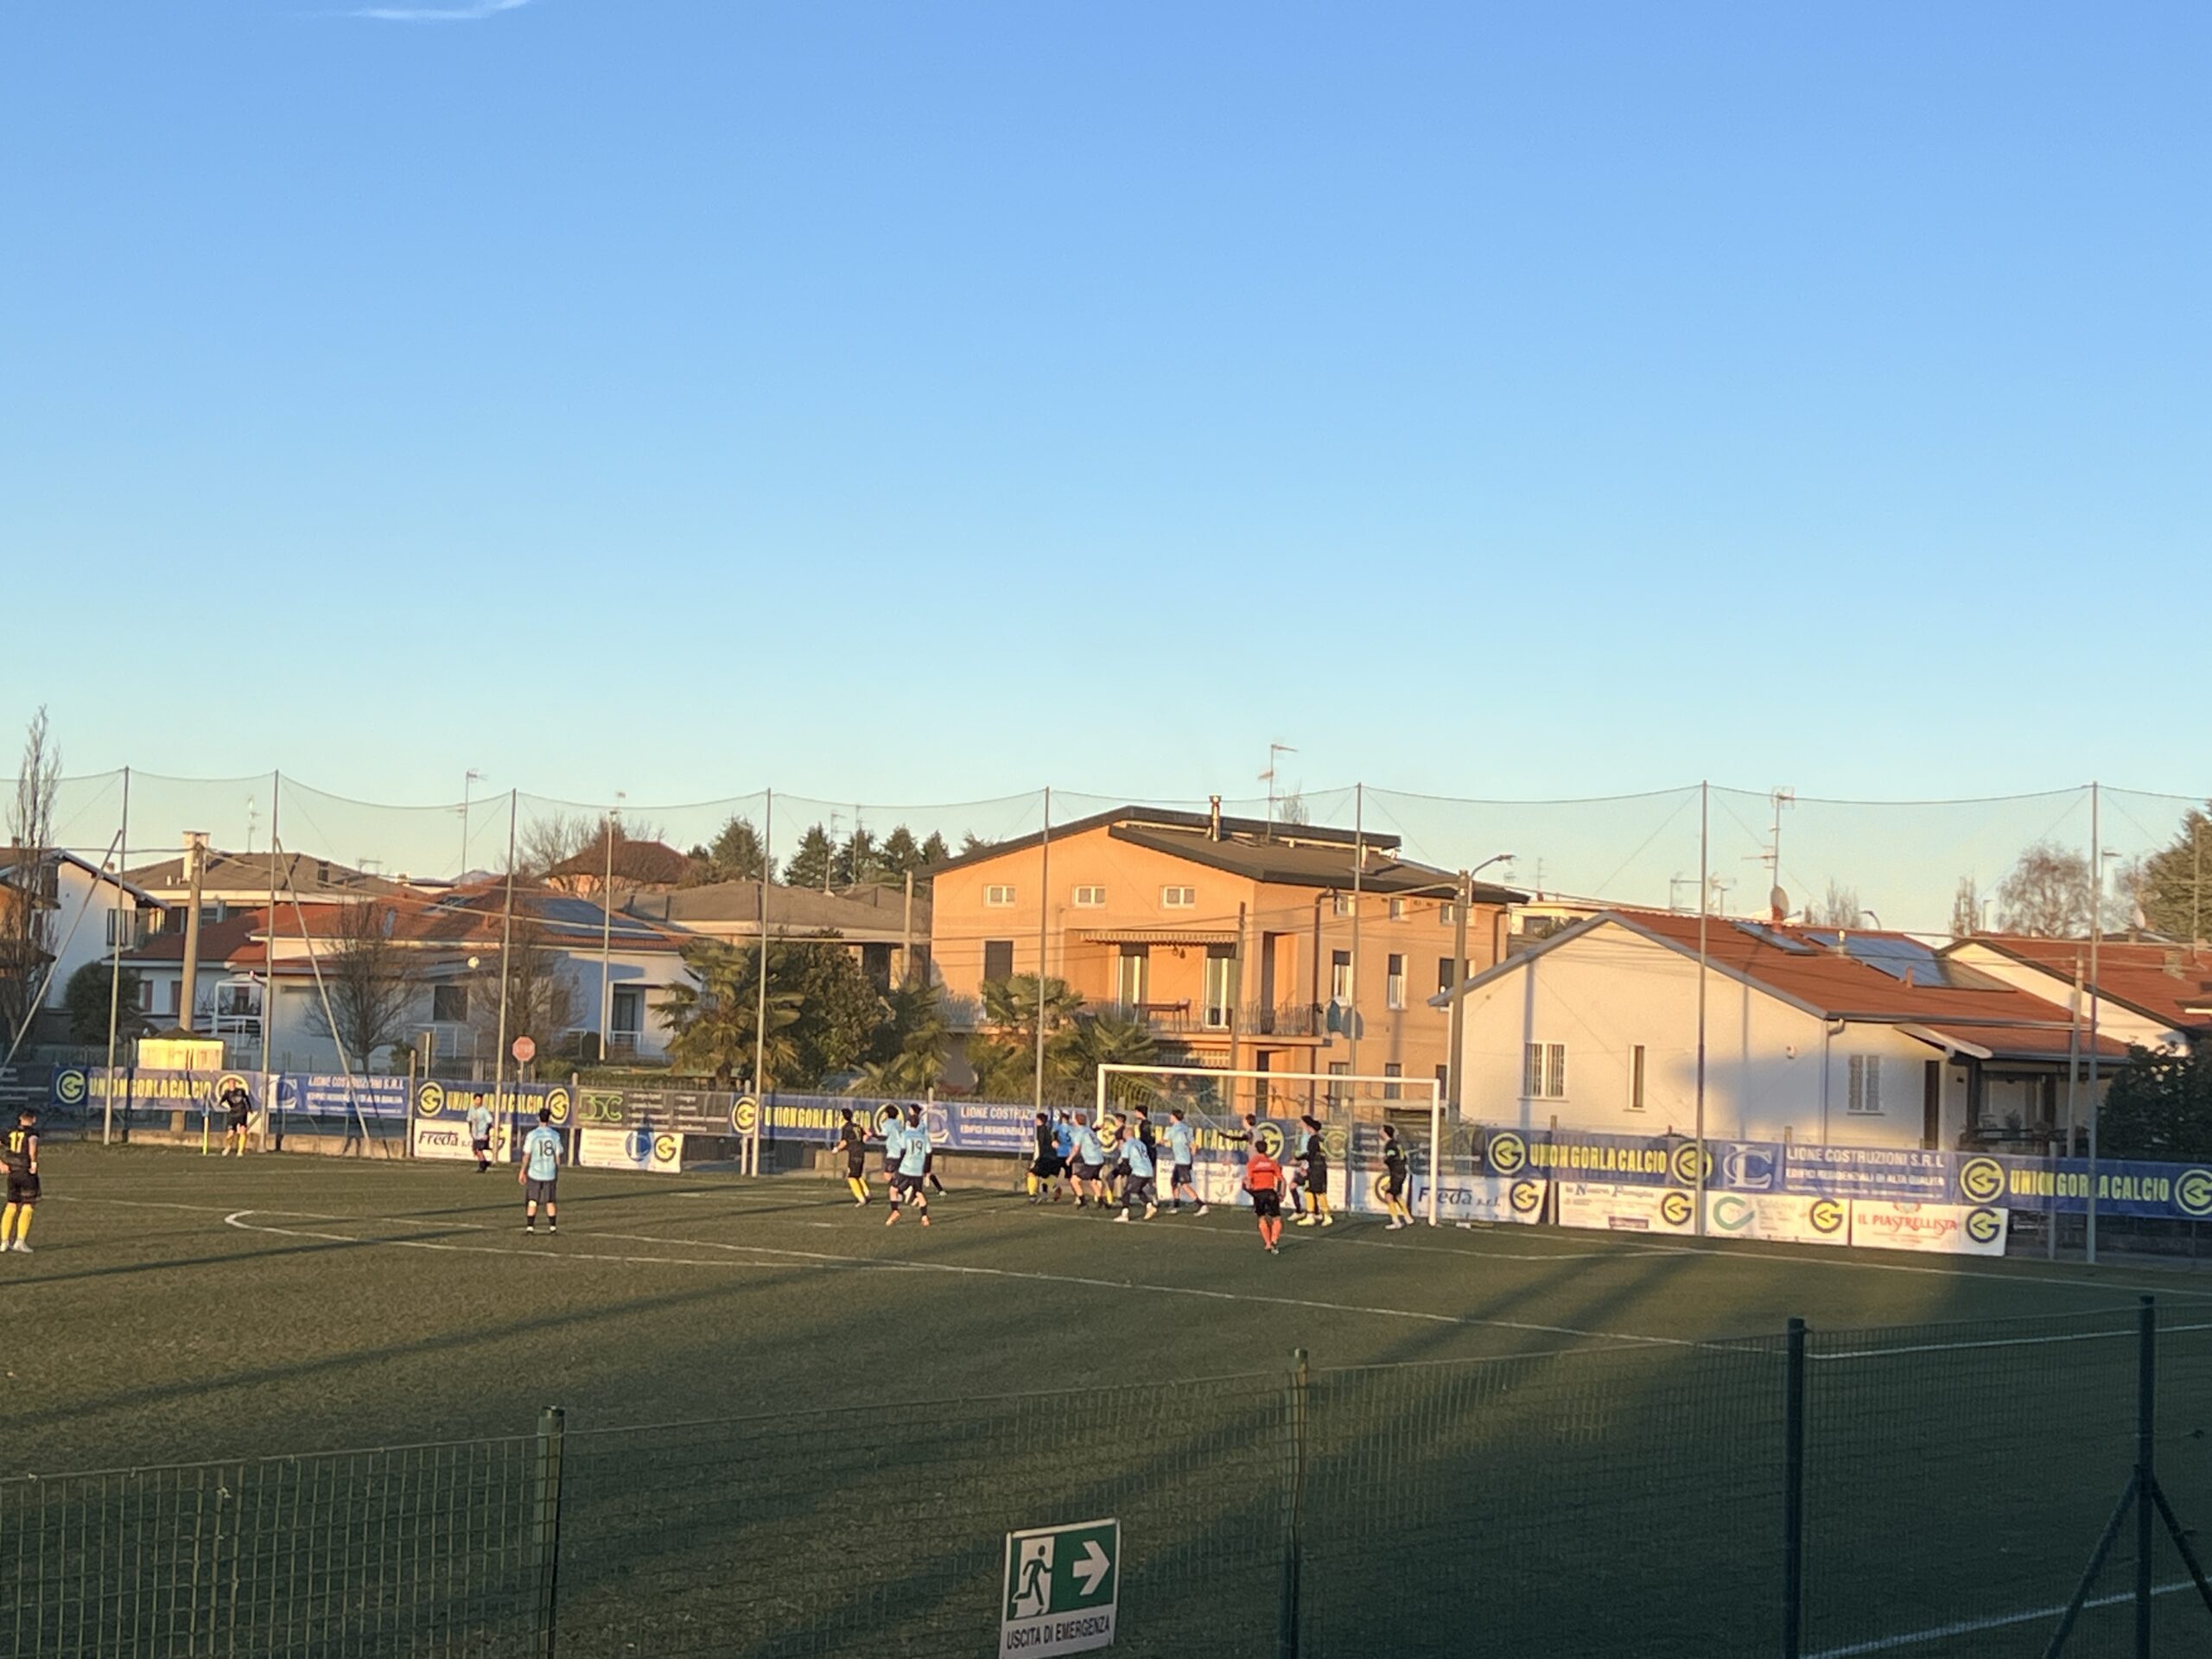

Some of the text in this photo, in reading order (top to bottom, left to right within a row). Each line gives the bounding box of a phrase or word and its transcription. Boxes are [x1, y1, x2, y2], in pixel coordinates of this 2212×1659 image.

[9, 1131, 24, 1154] 17
[419, 1130, 458, 1147] Freda
[911, 1139, 924, 1154] 19
[539, 1140, 555, 1157] 18
[1786, 1147, 1821, 1162] LIONE
[1824, 1149, 1907, 1166] COSTRUZIONI
[2010, 1169, 2170, 1202] UNION GORA CALCIO
[1419, 1186, 1471, 1205] Feda
[1007, 1614, 1110, 1649] USCITA DI EMERGENZA
